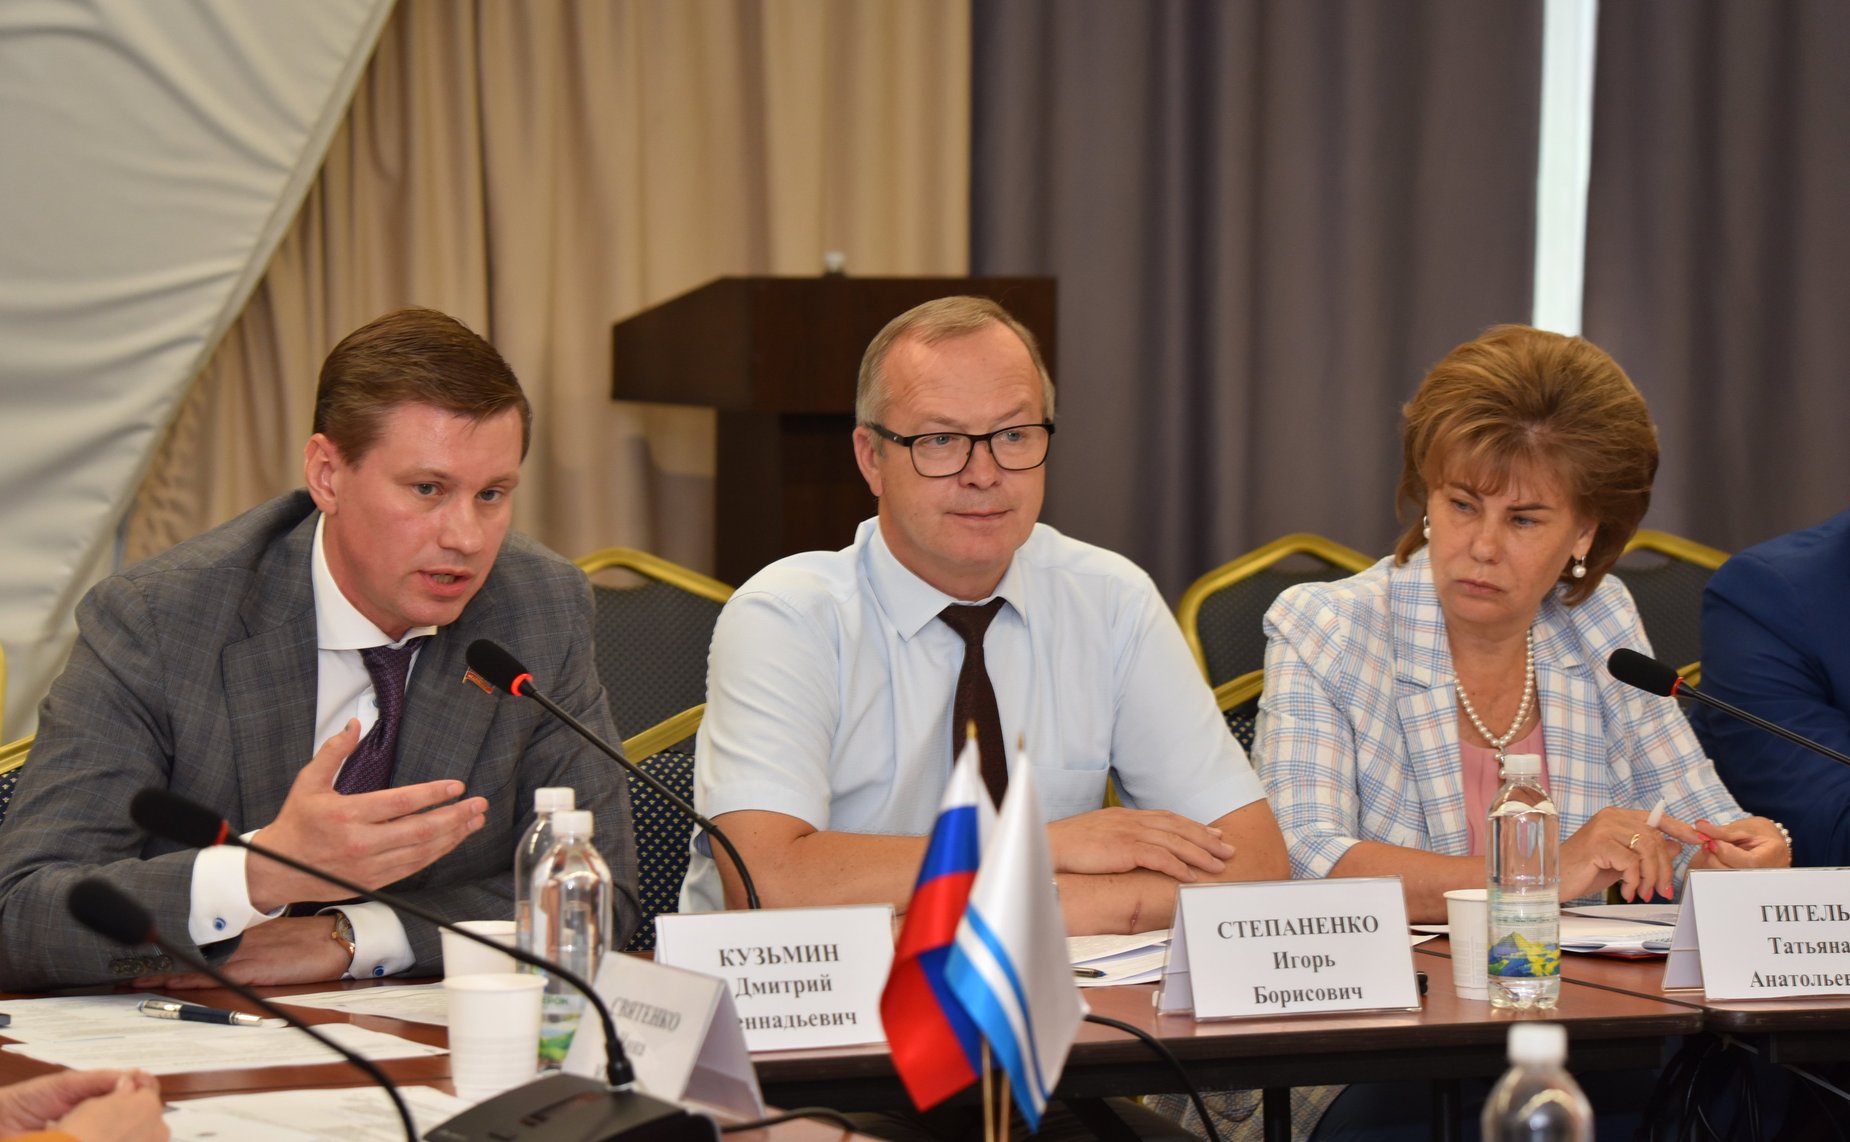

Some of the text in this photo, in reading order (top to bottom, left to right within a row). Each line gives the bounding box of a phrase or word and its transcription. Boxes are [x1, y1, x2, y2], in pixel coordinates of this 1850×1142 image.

[1760, 904, 1850, 922] ГИГЕЛЬ
[1217, 915, 1379, 939] СТЕПАНЕНКО
[719, 943, 840, 967] КУЗЬМИН
[1767, 936, 1850, 954] Татьяна
[1273, 951, 1336, 973] Игорь
[735, 974, 833, 999] Дмитрий
[1253, 986, 1363, 1008] Борисович
